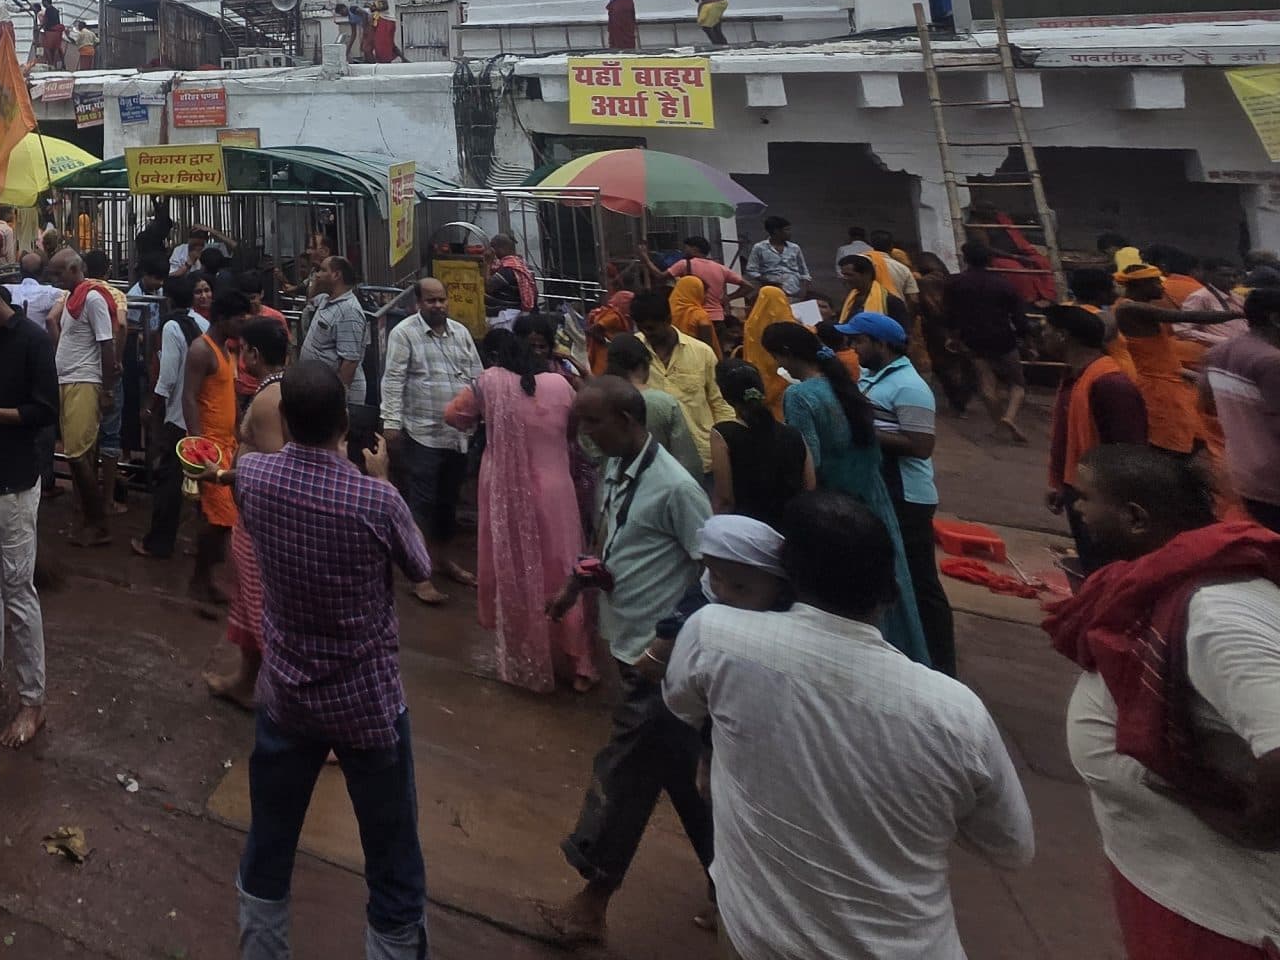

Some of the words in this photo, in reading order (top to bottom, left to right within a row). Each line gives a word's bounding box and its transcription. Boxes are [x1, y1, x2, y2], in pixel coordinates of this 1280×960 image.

[571, 60, 623, 87] यहाँ
[590, 90, 649, 118] अर्घा
[137, 152, 183, 166] निकास
[189, 153, 216, 167] द्वार
[134, 169, 174, 188] (प्रवेश
[176, 167, 222, 186] निषेध)
